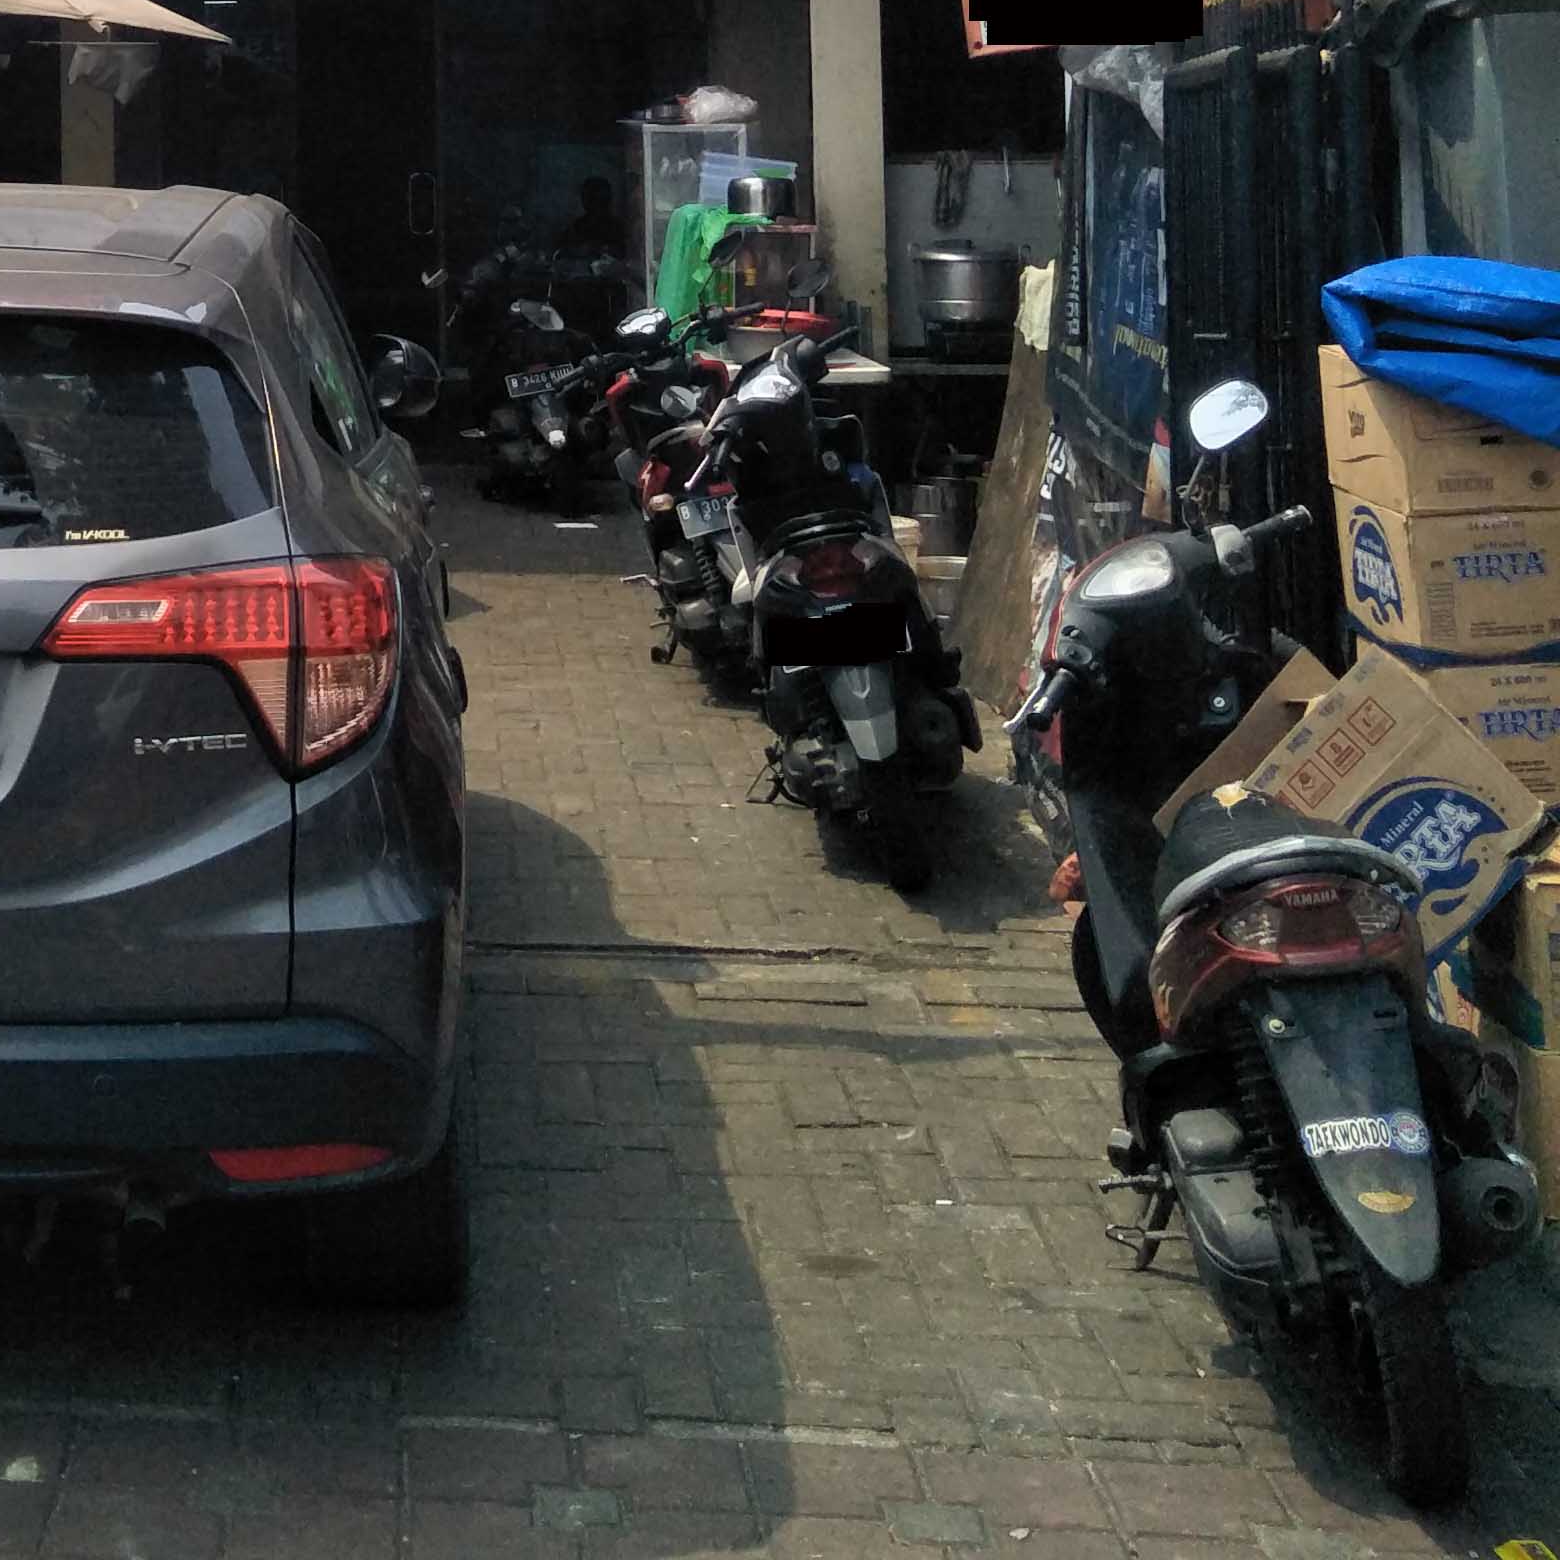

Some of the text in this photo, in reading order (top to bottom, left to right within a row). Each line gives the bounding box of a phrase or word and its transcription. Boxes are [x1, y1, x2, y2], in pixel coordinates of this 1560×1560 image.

[680, 505, 691, 521] B
[1354, 546, 1398, 605] TIRTA
[1453, 551, 1545, 584] TIRTA
[1380, 799, 1425, 849] Mineral
[1282, 888, 1339, 908] YAMAHA
[1306, 1117, 1392, 1157] TAEKWONDO
